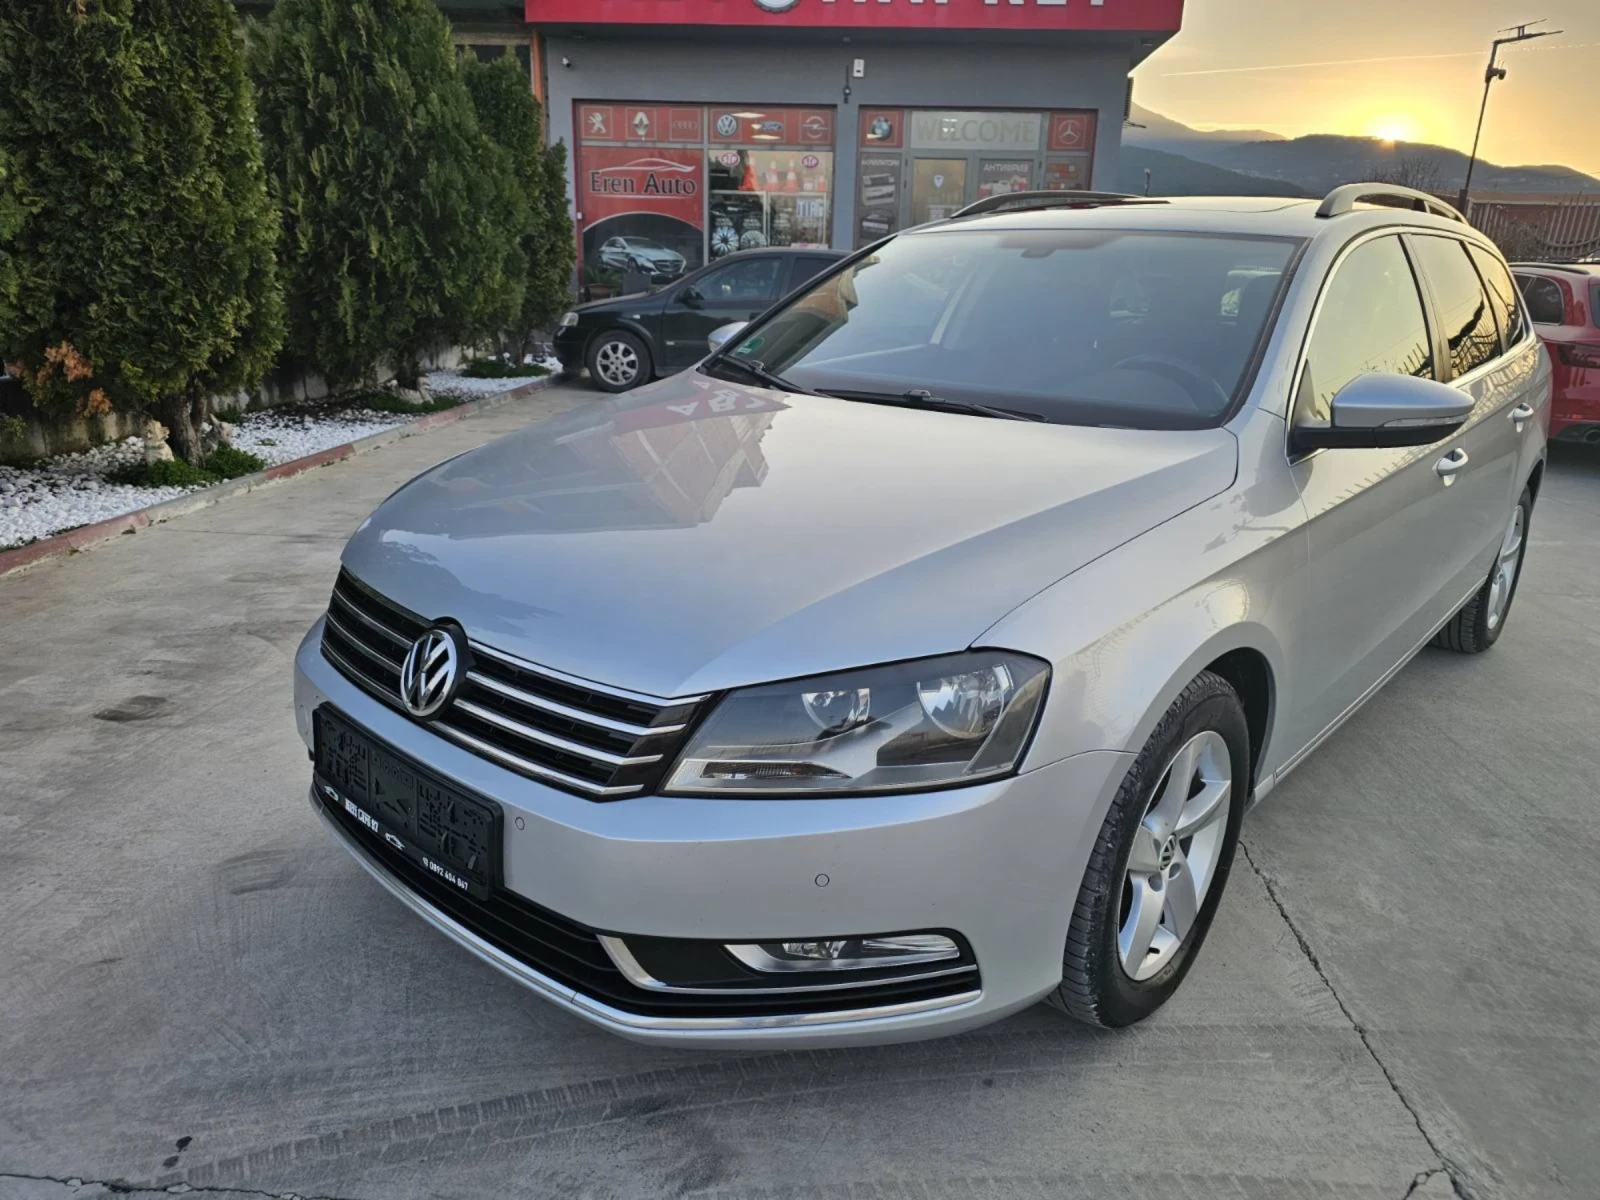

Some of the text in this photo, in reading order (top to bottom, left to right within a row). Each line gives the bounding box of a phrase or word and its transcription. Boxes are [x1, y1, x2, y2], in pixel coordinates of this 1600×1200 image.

[917, 118, 1037, 143] WELCOME
[721, 153, 739, 166] STP
[802, 156, 818, 168] STP
[590, 170, 696, 195] Eren Auto
